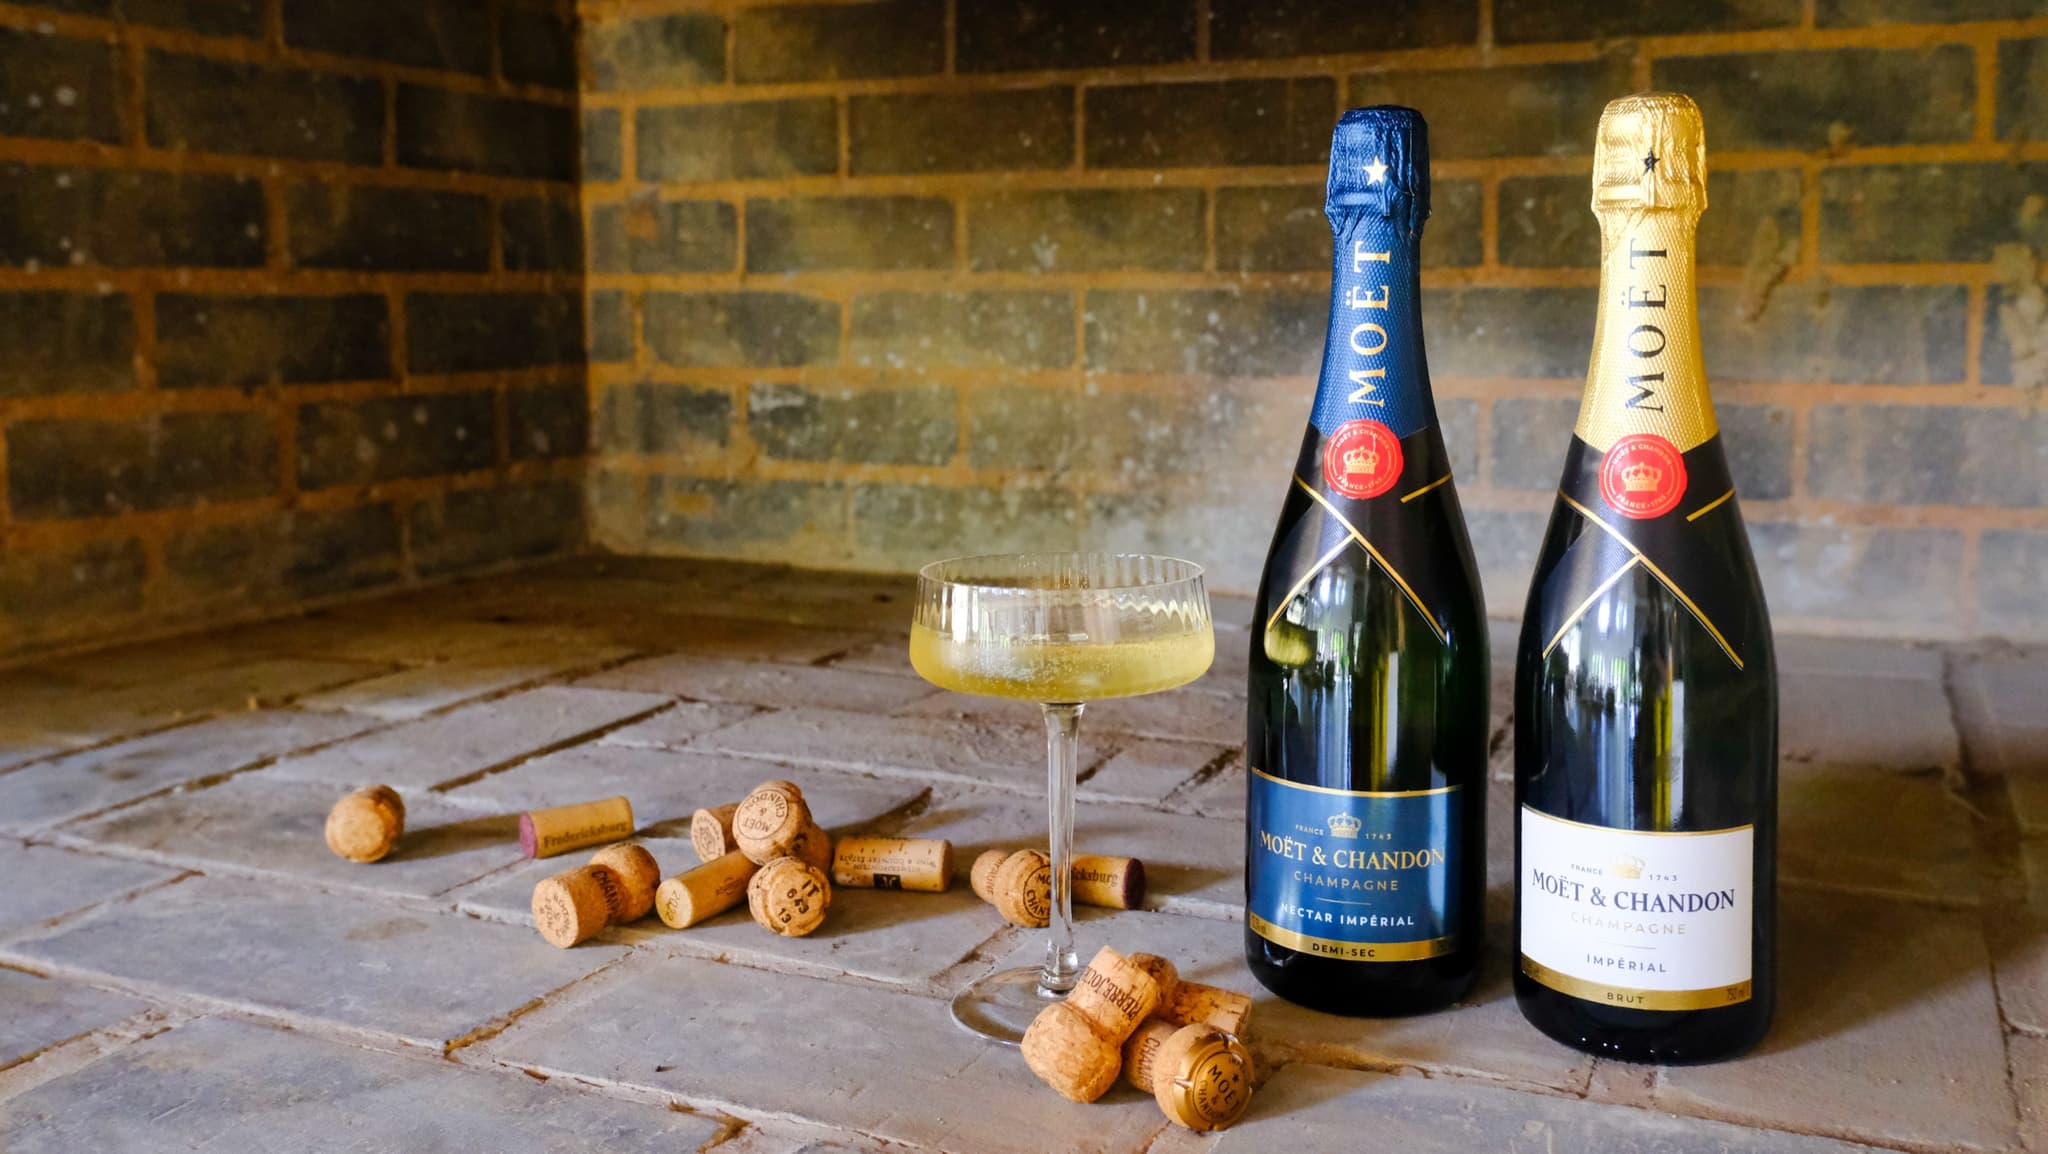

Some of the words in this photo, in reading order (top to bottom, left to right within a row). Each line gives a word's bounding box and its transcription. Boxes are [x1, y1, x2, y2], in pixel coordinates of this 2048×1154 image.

[1345, 241, 1391, 408] MOËT
[1621, 238, 1667, 413] MOËT
[1295, 824, 1325, 836] FRANCE
[1260, 830, 1307, 861] MOËT
[1311, 847, 1327, 866] &
[1333, 848, 1446, 871] CHANDON
[1294, 871, 1400, 891] CHAMPAGNE
[1571, 864, 1603, 876] FRANCE
[1649, 874, 1678, 882] 1743
[1532, 869, 1584, 901] MOËT
[1590, 886, 1607, 907] &
[1614, 889, 1735, 913] CHANDON
[1280, 903, 1333, 923] NECTAR
[1340, 912, 1415, 927] IMPÉRIAL
[1571, 911, 1687, 935] CHAMPAGNE
[1312, 942, 1376, 958] DEMI-SEC
[1586, 953, 1667, 973] IMPÉRIAL
[1607, 991, 1645, 1004] BRUT
